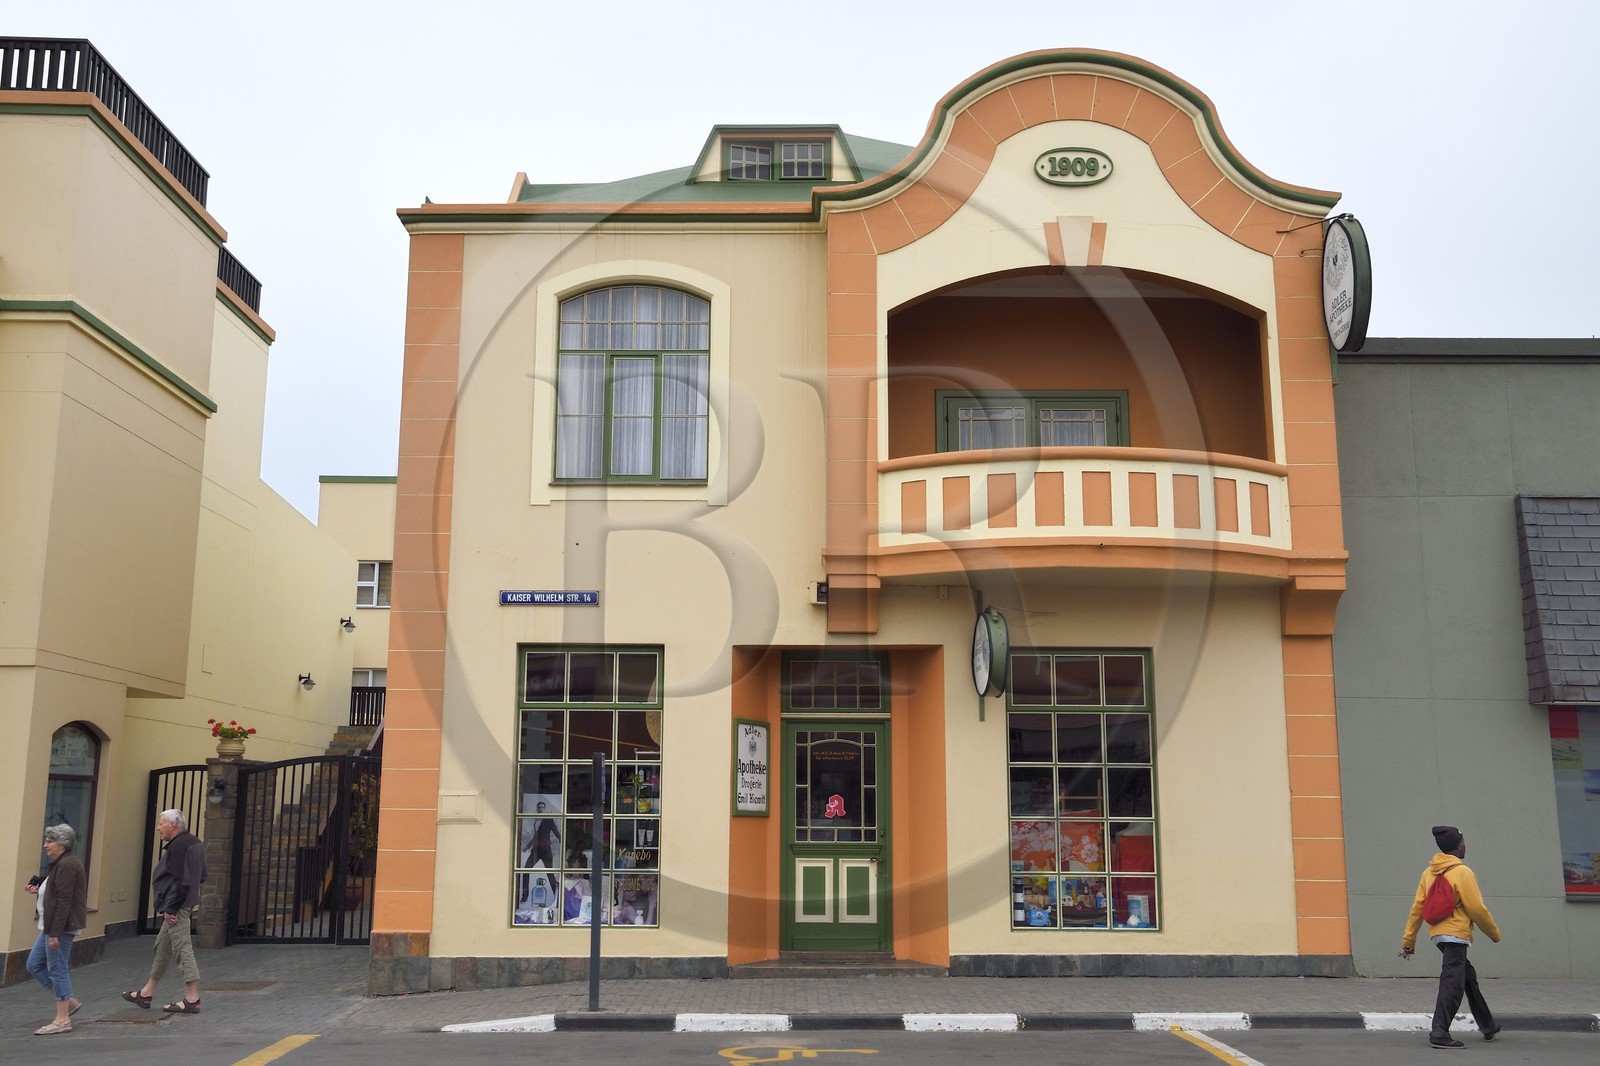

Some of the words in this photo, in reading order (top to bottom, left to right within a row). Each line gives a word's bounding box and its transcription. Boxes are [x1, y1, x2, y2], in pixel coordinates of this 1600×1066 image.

[1048, 156, 1099, 176] 1909
[1331, 289, 1347, 311] ADLER
[1329, 297, 1352, 325] APOTHEKE
[507, 593, 531, 602] KAISER
[534, 593, 564, 602] WILHELM
[566, 593, 580, 602] STR.
[737, 759, 767, 776] Apotheke
[741, 778, 762, 791] Drogerie
[737, 792, 748, 804] Emil
[617, 877, 656, 891] COSMETICS
